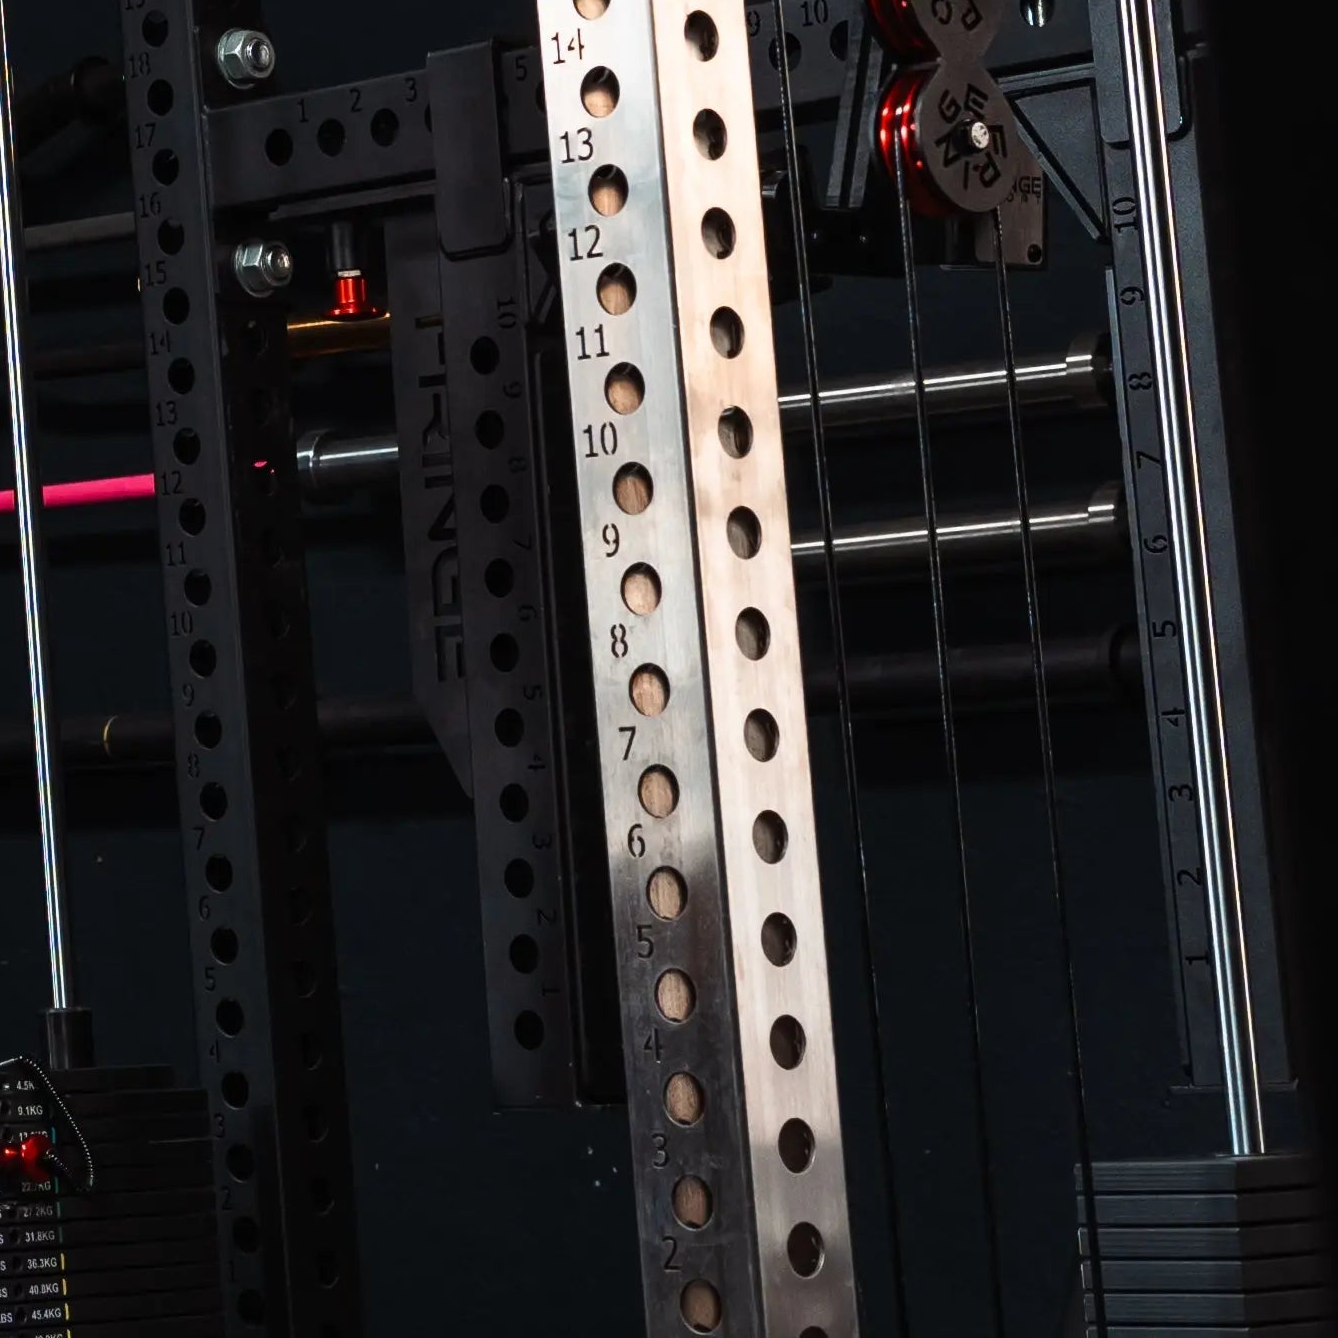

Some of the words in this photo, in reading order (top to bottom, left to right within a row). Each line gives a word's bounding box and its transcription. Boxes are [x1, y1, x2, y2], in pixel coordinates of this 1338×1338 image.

[551, 28, 585, 65] 14
[515, 57, 527, 82] 5
[349, 88, 363, 113] 2
[405, 77, 418, 103] 3
[298, 98, 309, 123] 1
[134, 121, 157, 149] 17
[559, 127, 594, 163] 13
[139, 191, 162, 218] 16
[1114, 196, 1136, 232] 10
[568, 225, 603, 261] 12
[144, 260, 168, 287] 15
[1122, 287, 1144, 306] 9
[575, 324, 610, 360] 11
[1129, 371, 1152, 392] 8
[583, 422, 618, 458] 10
[1136, 450, 1160, 469] 7
[160, 470, 184, 496] 12
[165, 540, 187, 566] 11
[602, 523, 620, 558] 9
[1144, 534, 1168, 554] 6
[169, 609, 193, 638] 10
[1153, 620, 1177, 639] 5
[610, 623, 629, 659] 8
[1161, 709, 1185, 727] 4
[618, 726, 636, 761] 7
[1169, 784, 1193, 802] 3
[192, 827, 205, 851] 7
[627, 823, 645, 858] 6
[1178, 869, 1203, 886] 2
[635, 925, 654, 960] 5
[1187, 951, 1210, 964] 1
[644, 1028, 665, 1063] 4
[16, 1080, 36, 1091] 4.5K
[652, 1133, 669, 1169] 3
[662, 1236, 681, 1272] 2
